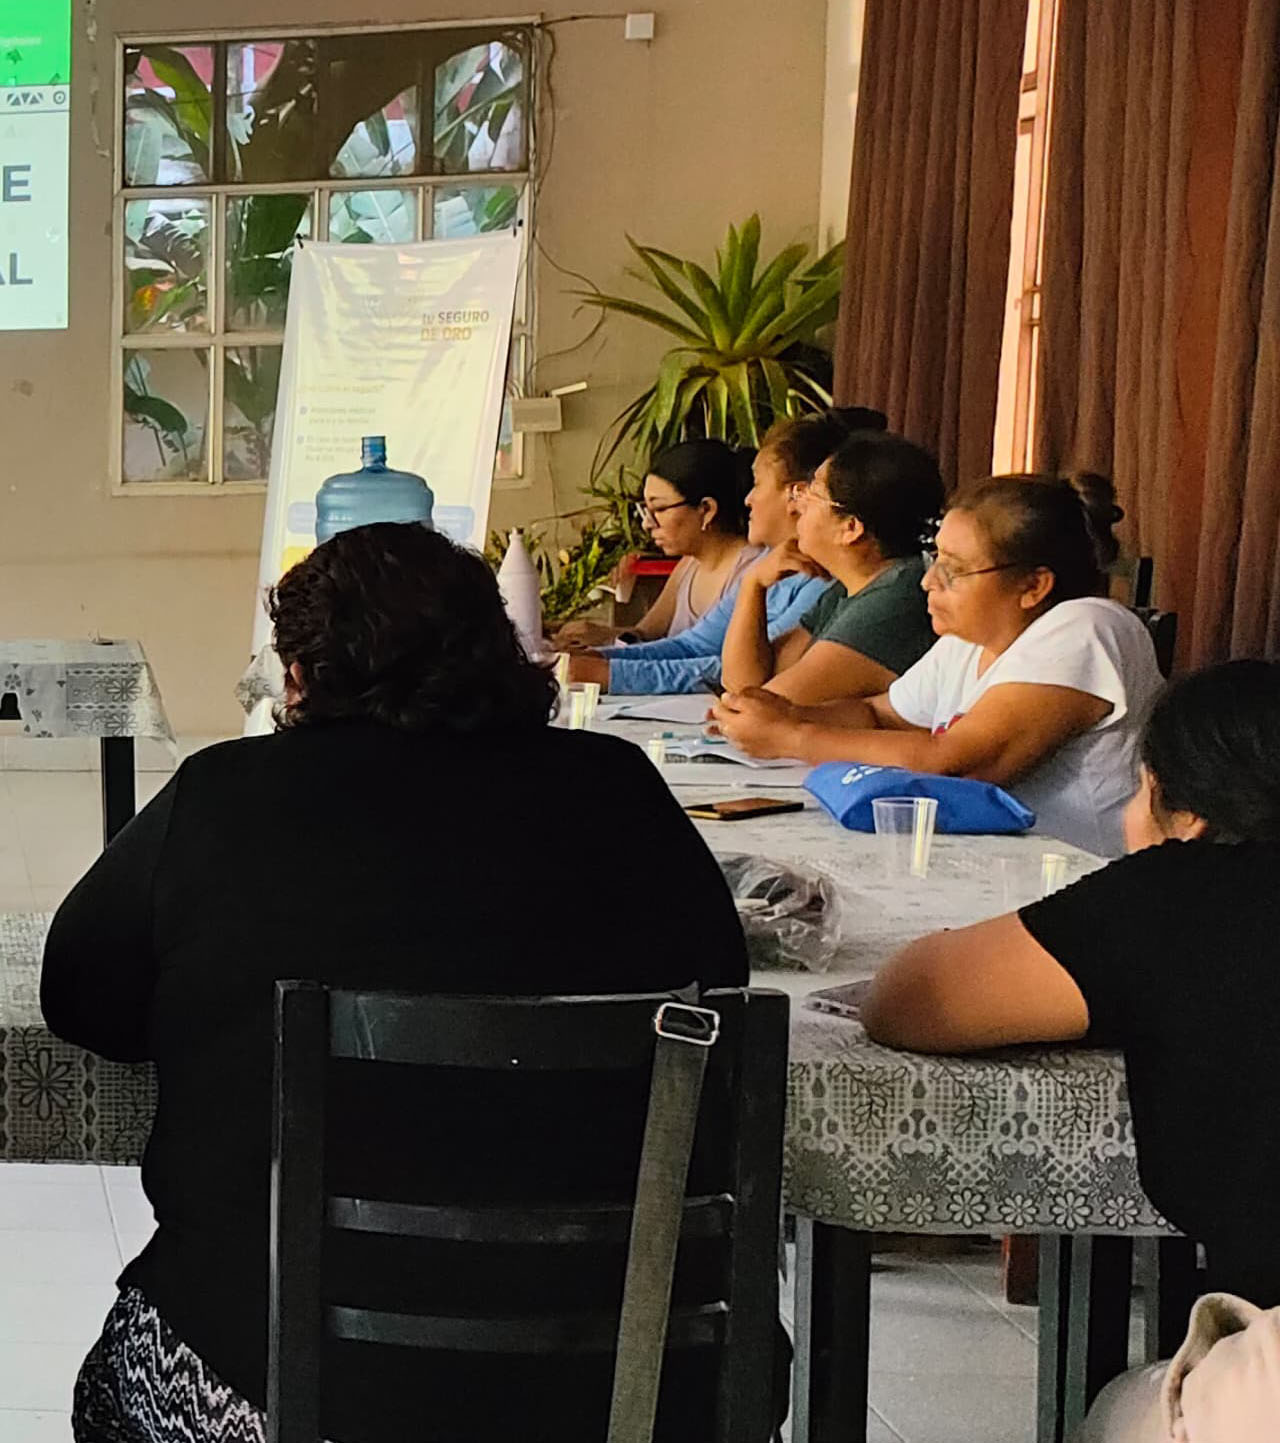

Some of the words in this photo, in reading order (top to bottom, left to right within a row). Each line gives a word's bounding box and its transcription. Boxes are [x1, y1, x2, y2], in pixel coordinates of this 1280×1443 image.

[438, 310, 490, 324] SEGURO
[420, 327, 436, 342] DE
[442, 326, 472, 341] ORO
